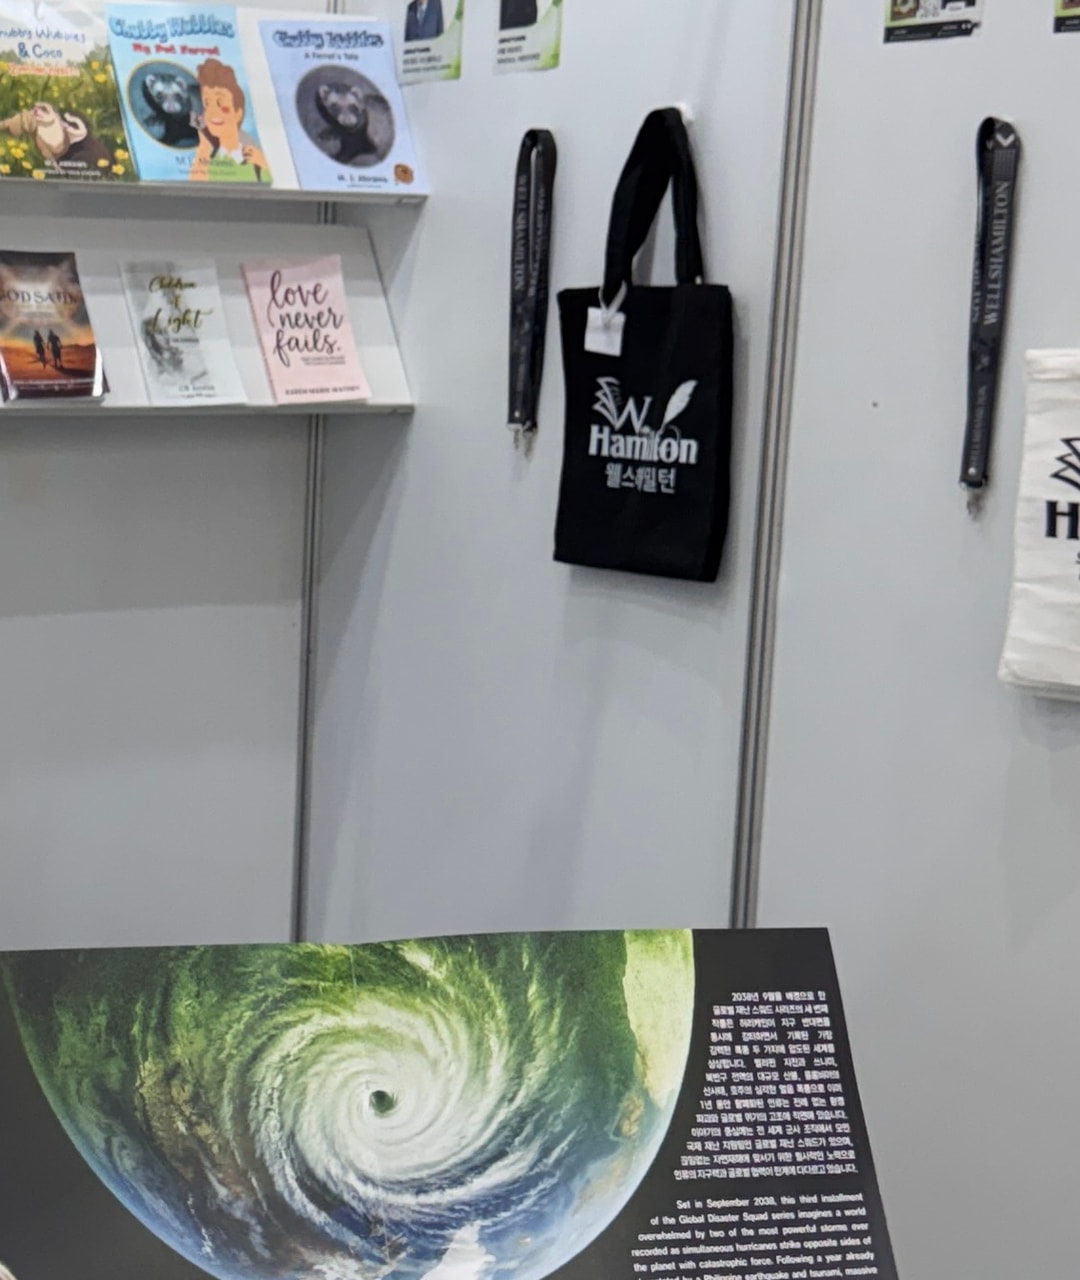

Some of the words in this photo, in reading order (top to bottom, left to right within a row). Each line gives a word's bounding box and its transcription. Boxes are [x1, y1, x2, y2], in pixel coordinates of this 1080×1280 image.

[983, 179, 1009, 326] WELLSHAMILTON
[267, 270, 329, 328] love
[279, 306, 345, 329] never
[273, 328, 341, 368] fails.
[677, 1200, 691, 1210] Set
[695, 1200, 703, 1209] in
[706, 1198, 750, 1210] September
[780, 1195, 796, 1205] this
[799, 1194, 818, 1204] third
[820, 1192, 864, 1203] installment
